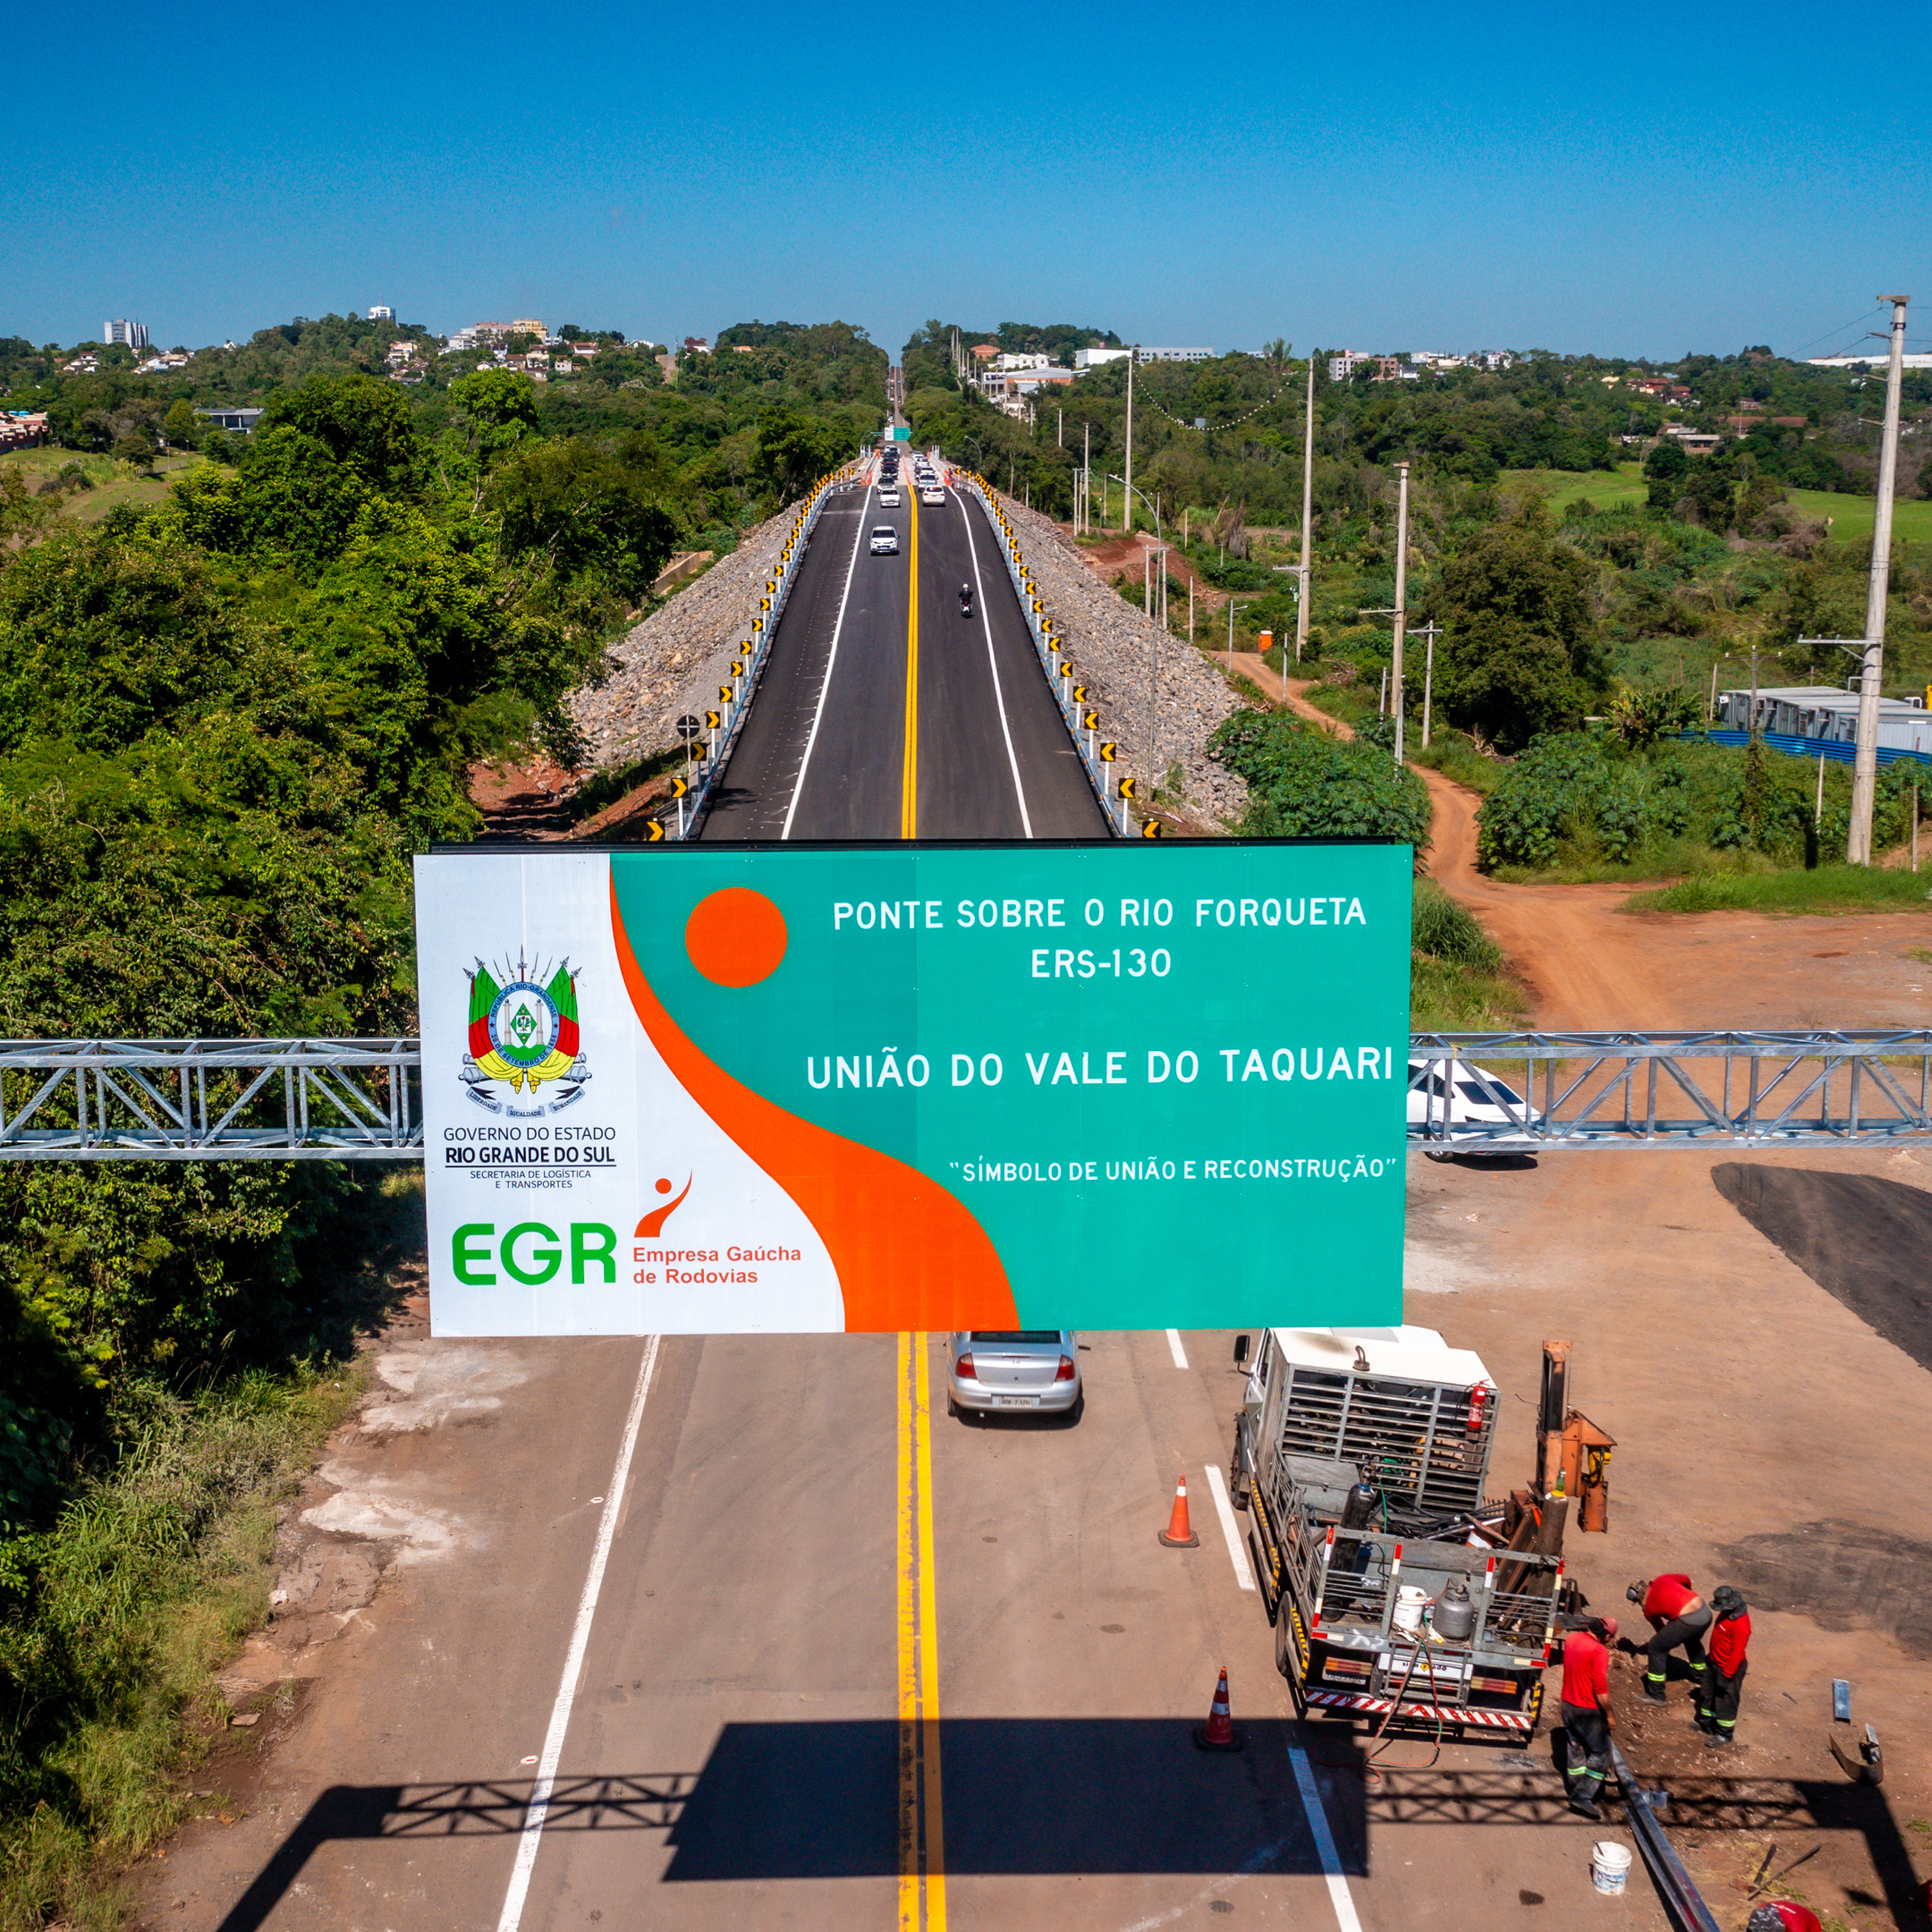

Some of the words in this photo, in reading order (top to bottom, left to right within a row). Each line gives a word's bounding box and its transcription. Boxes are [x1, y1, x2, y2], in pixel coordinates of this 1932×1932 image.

[834, 901, 944, 930] PONTE
[957, 898, 1065, 928] SOBRE
[1084, 898, 1104, 927] O
[1121, 898, 1174, 927] RIO
[1196, 897, 1367, 927] FORQUETA
[1031, 948, 1171, 979] ERS-130
[495, 1043, 504, 1053] DE
[503, 1053, 540, 1066] SETEMBRO
[807, 1046, 930, 1089] UNIÃO
[952, 1053, 1003, 1087] DO
[1025, 1051, 1127, 1085] VALE
[1148, 1050, 1199, 1083] DO
[1219, 1046, 1392, 1082] TAQUARI
[444, 1127, 521, 1141] GOVERNO
[526, 1127, 550, 1140] DO
[555, 1127, 616, 1140] ESTADO
[445, 1147, 476, 1164] RIO
[479, 1146, 550, 1164] GRANDE
[554, 1146, 580, 1163] DO
[583, 1146, 615, 1163] SUL
[470, 1170, 526, 1179] SECRETARIA
[528, 1170, 540, 1179] DE
[543, 1168, 591, 1179] LOGÍSTICA
[1069, 1161, 1098, 1181] DE
[1106, 1156, 1175, 1181] UNIÃO
[1183, 1160, 1196, 1180] E
[495, 1180, 501, 1189] E
[505, 1180, 573, 1189] TRANSPORTES
[451, 1222, 617, 1285] EGR
[632, 1247, 719, 1265] Empresa
[726, 1245, 801, 1262] Gaúcha
[632, 1268, 657, 1284] de
[665, 1267, 758, 1284] Rodovias
